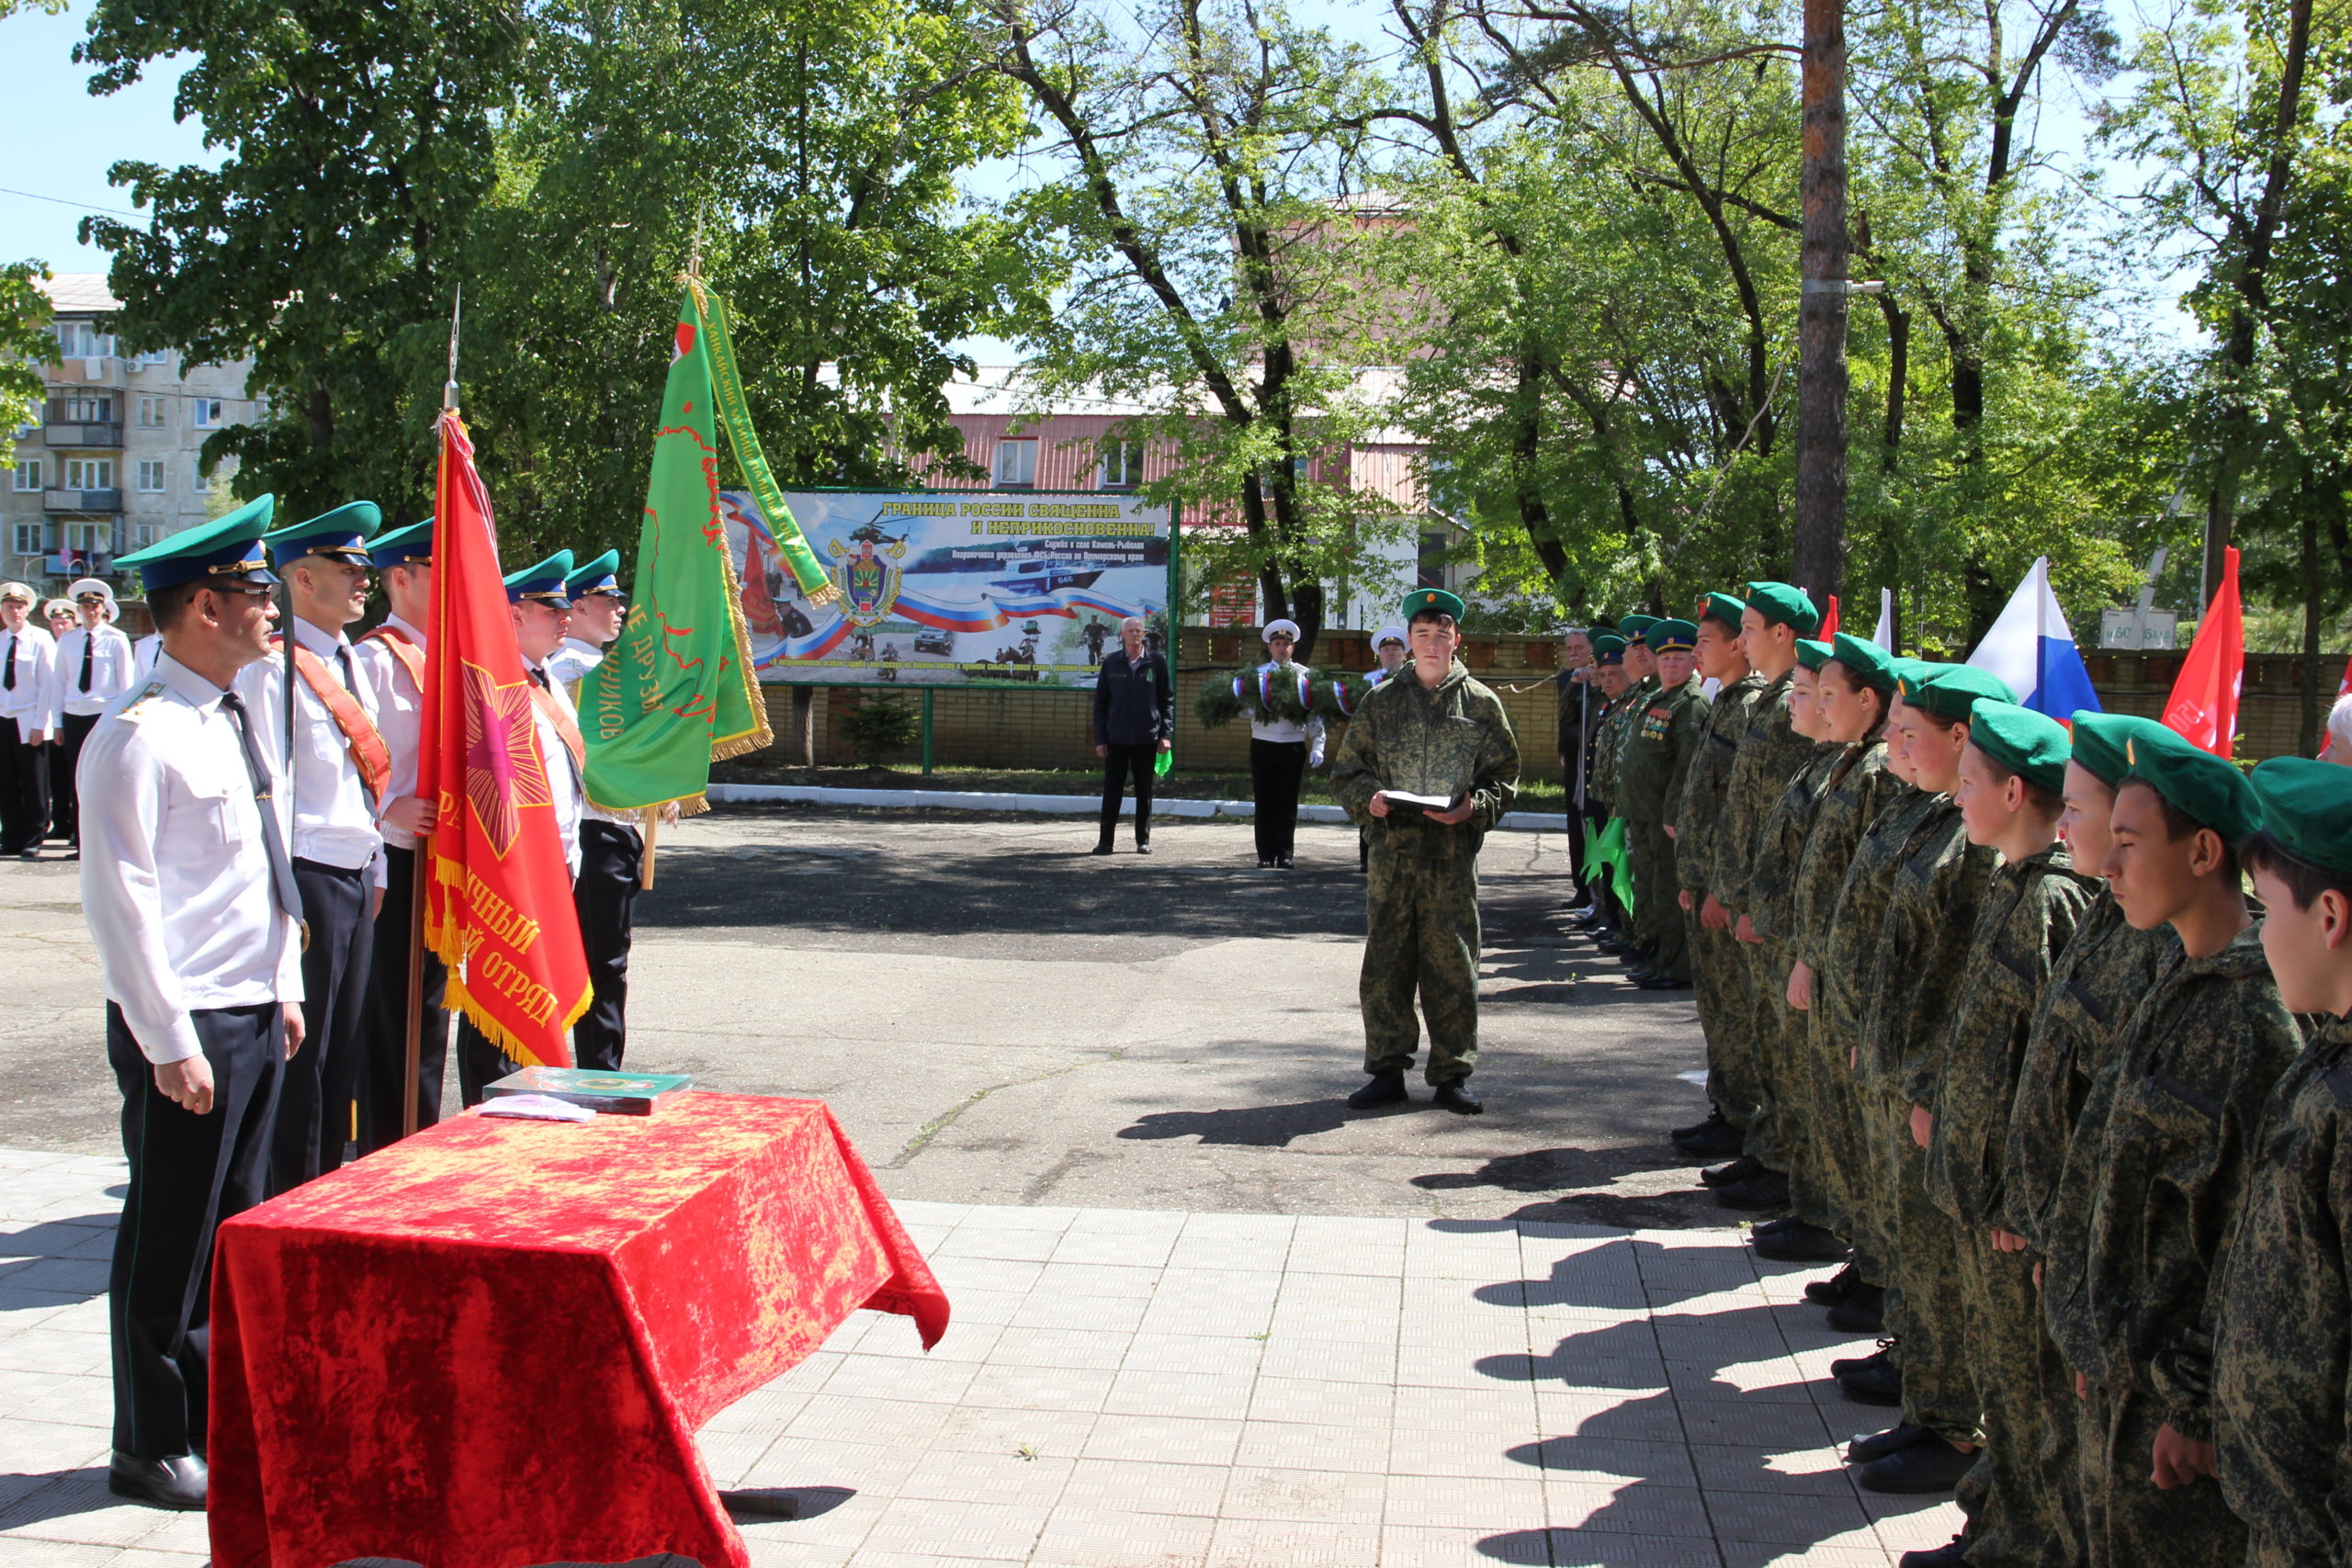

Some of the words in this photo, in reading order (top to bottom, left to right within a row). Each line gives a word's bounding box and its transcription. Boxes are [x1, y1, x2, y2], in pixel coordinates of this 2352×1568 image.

[707, 321, 738, 406] ХАНКАЙСКИЙ
[882, 502, 956, 518] ГРАНИЦА
[961, 503, 1024, 517] РОССИИ
[1028, 503, 1121, 519] СВЯЩЕННА
[971, 521, 983, 535] И
[987, 522, 1155, 536] НЕПРИКОСНОВЕННА!
[1057, 576, 1073, 584] 646
[481, 951, 559, 1030] ОТРЯД
